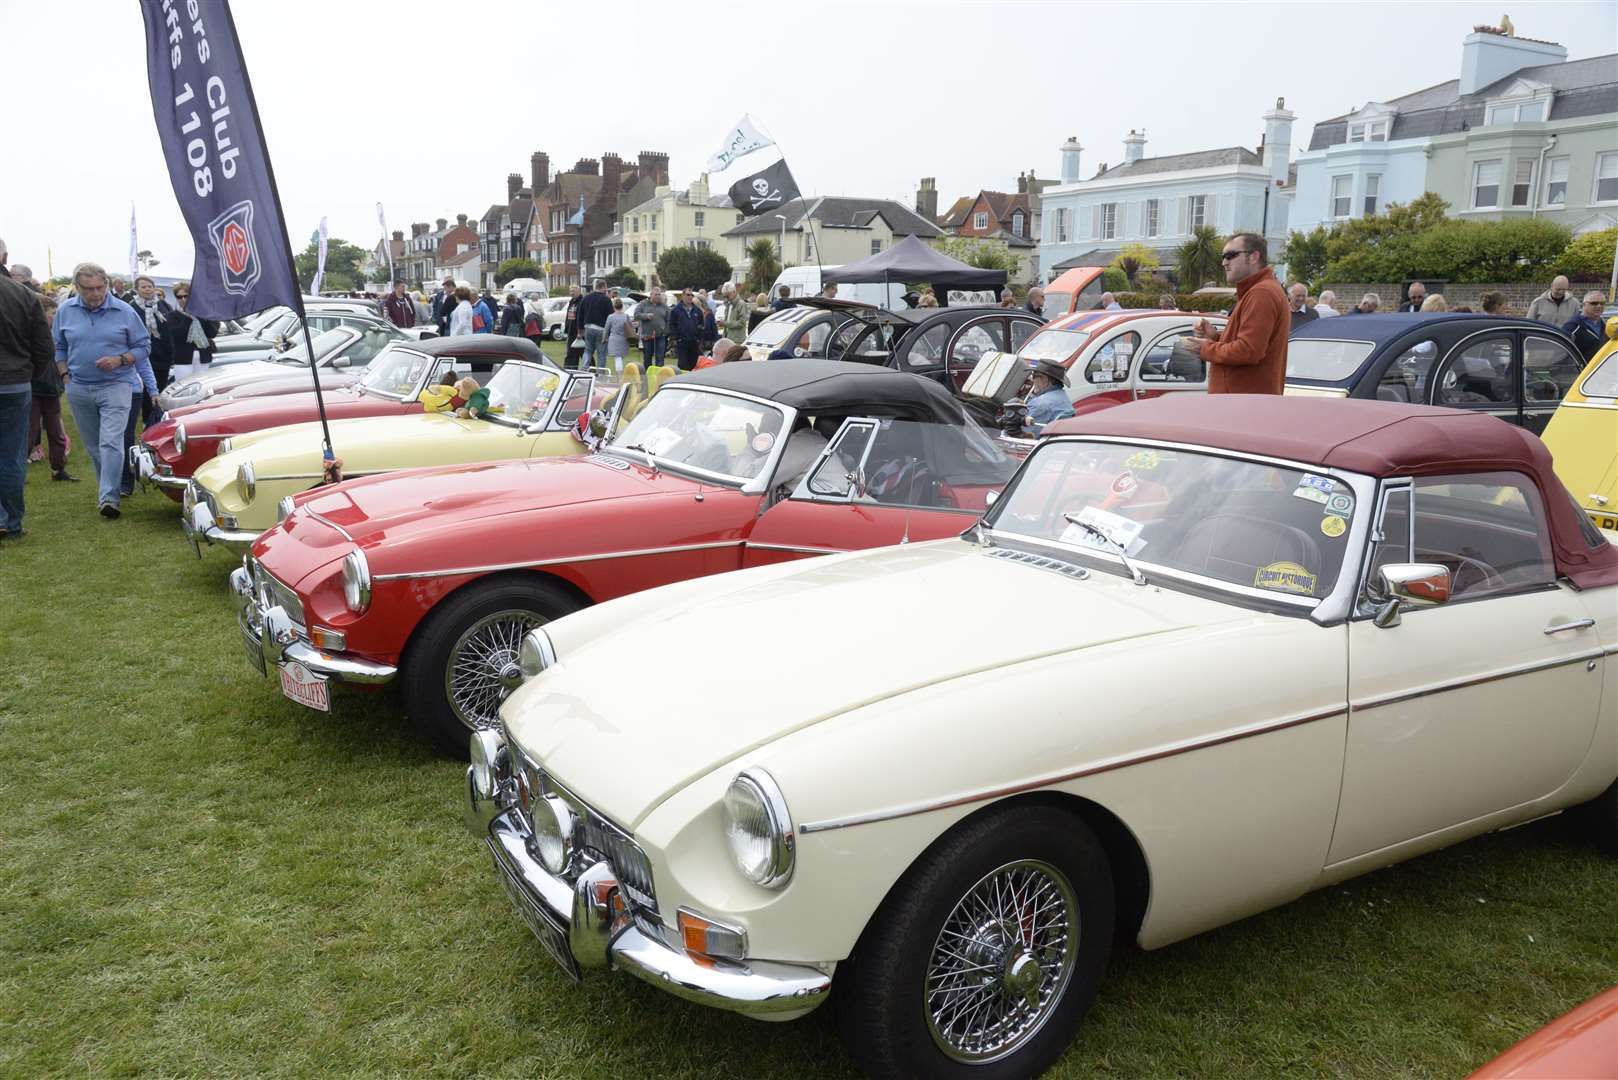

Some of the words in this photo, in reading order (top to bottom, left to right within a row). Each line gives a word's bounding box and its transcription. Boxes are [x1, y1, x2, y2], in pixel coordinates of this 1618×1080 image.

[175, 82, 214, 198] 1108
[206, 76, 240, 180] Club
[225, 227, 246, 269] MG
